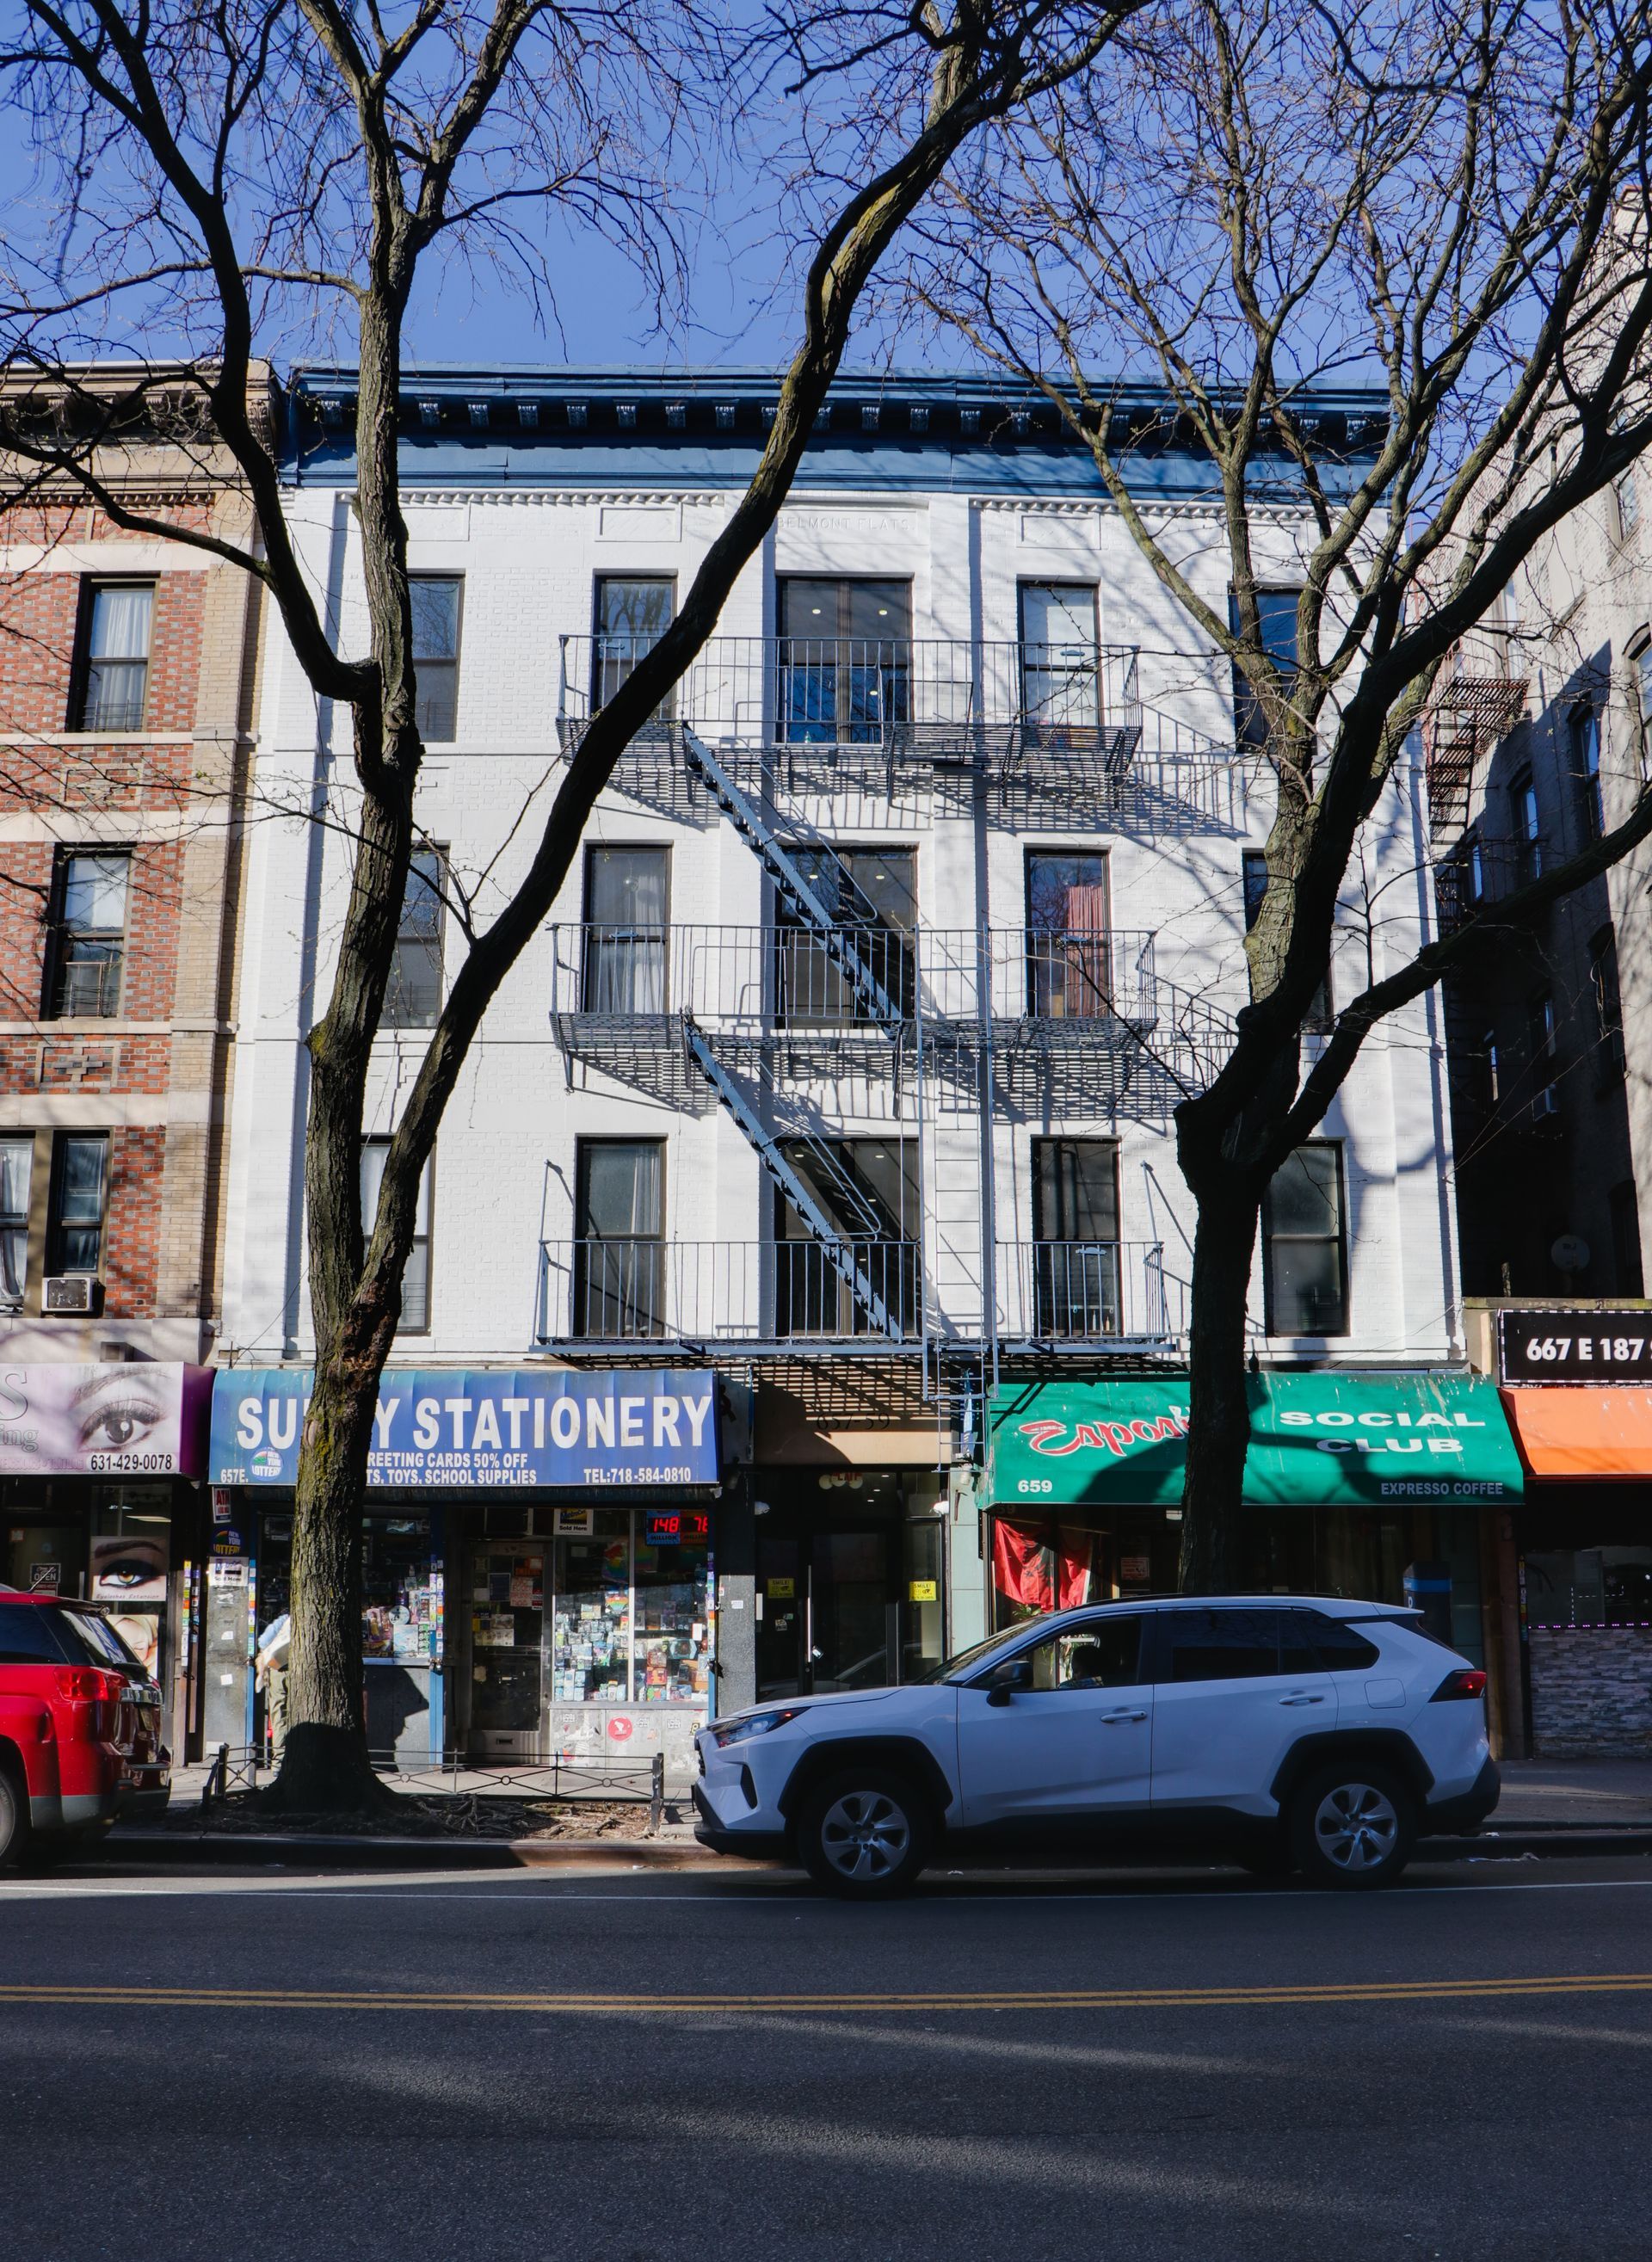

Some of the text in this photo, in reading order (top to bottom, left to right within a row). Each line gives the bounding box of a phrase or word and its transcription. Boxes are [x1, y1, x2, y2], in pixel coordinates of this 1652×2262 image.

[778, 517, 850, 530] BELMONT
[1526, 1338, 1571, 1361] 667
[1578, 1338, 1592, 1360] E
[1600, 1338, 1644, 1361] 187
[237, 1396, 712, 1450] SUY STATIONERY
[1279, 1411, 1486, 1427] SOCIAL
[1316, 1438, 1464, 1453] CLUB
[90, 1454, 172, 1471] 631-429-0078
[367, 1452, 528, 1469] REETING CARDS 50% OFF
[424, 1469, 475, 1485] SCHOOL
[477, 1469, 537, 1485] SUPPLIES
[1018, 1479, 1053, 1493] 659
[1380, 1482, 1503, 1495] EXPRESSO COFFEE
[653, 1516, 679, 1533] 148
